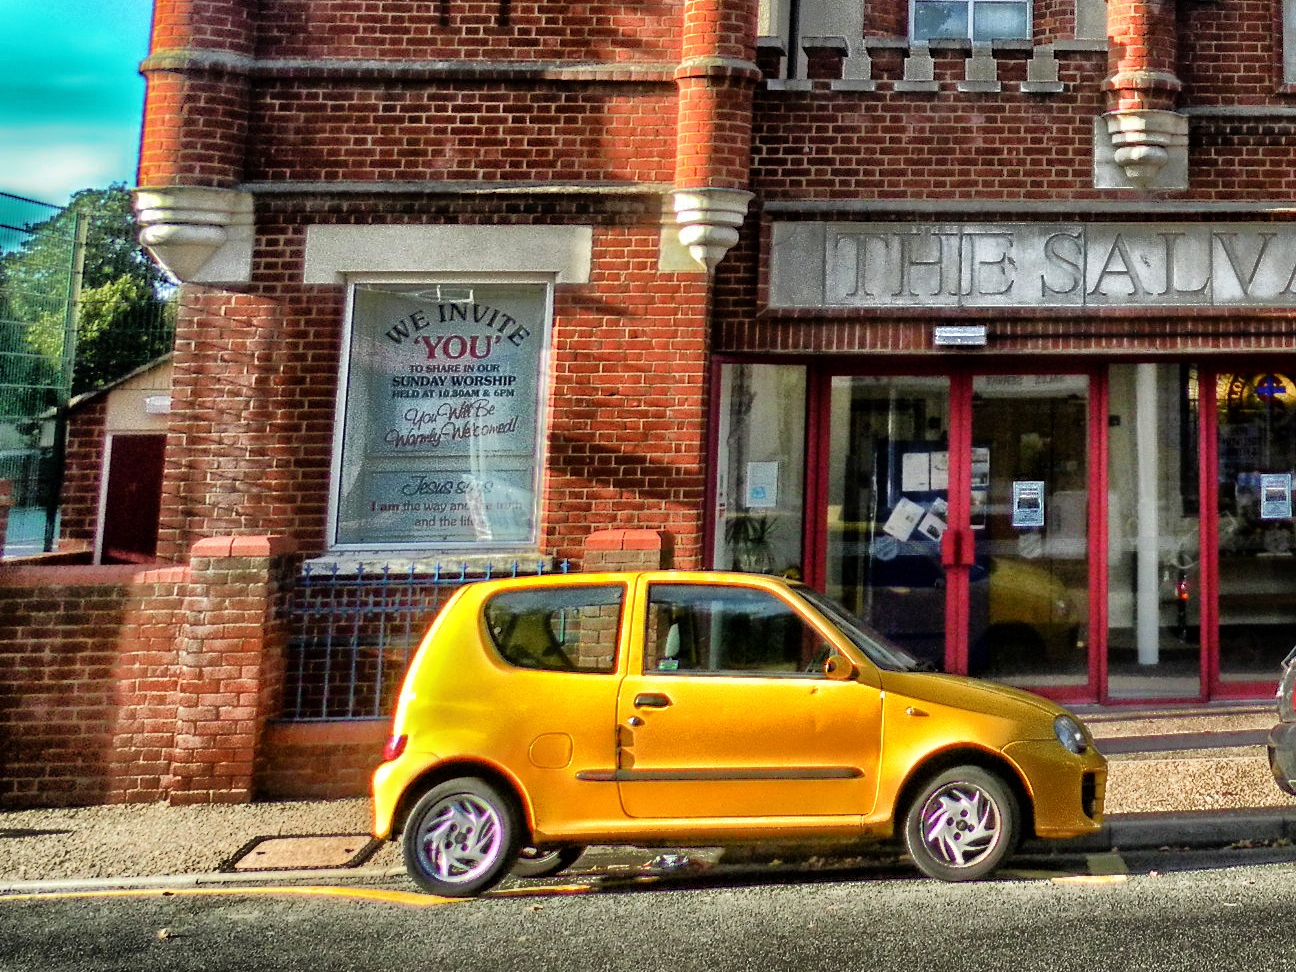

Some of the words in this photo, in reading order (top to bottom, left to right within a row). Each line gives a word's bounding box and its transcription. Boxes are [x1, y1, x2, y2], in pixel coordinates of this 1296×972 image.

[834, 231, 1017, 298] THE
[385, 310, 432, 345] WE
[437, 303, 531, 347] INVITE
[408, 364, 424, 373] TO
[425, 364, 461, 373] SHARE
[462, 363, 474, 373] IN
[475, 363, 500, 373] OUR
[392, 375, 448, 387] SUNDAY
[451, 375, 517, 386] WORSHIP
[392, 389, 420, 398] HELD
[421, 389, 436, 398] AT
[482, 388, 490, 397] &
[493, 388, 515, 397] 6PM
[404, 408, 438, 430] You
[472, 398, 496, 418] Be
[384, 428, 441, 447] Warmly
[402, 475, 453, 497] Jesus
[456, 479, 493, 496] ss
[379, 502, 400, 512] am
[402, 500, 421, 511] the
[423, 502, 447, 513] way
[414, 516, 436, 527] and
[439, 516, 457, 527] the
